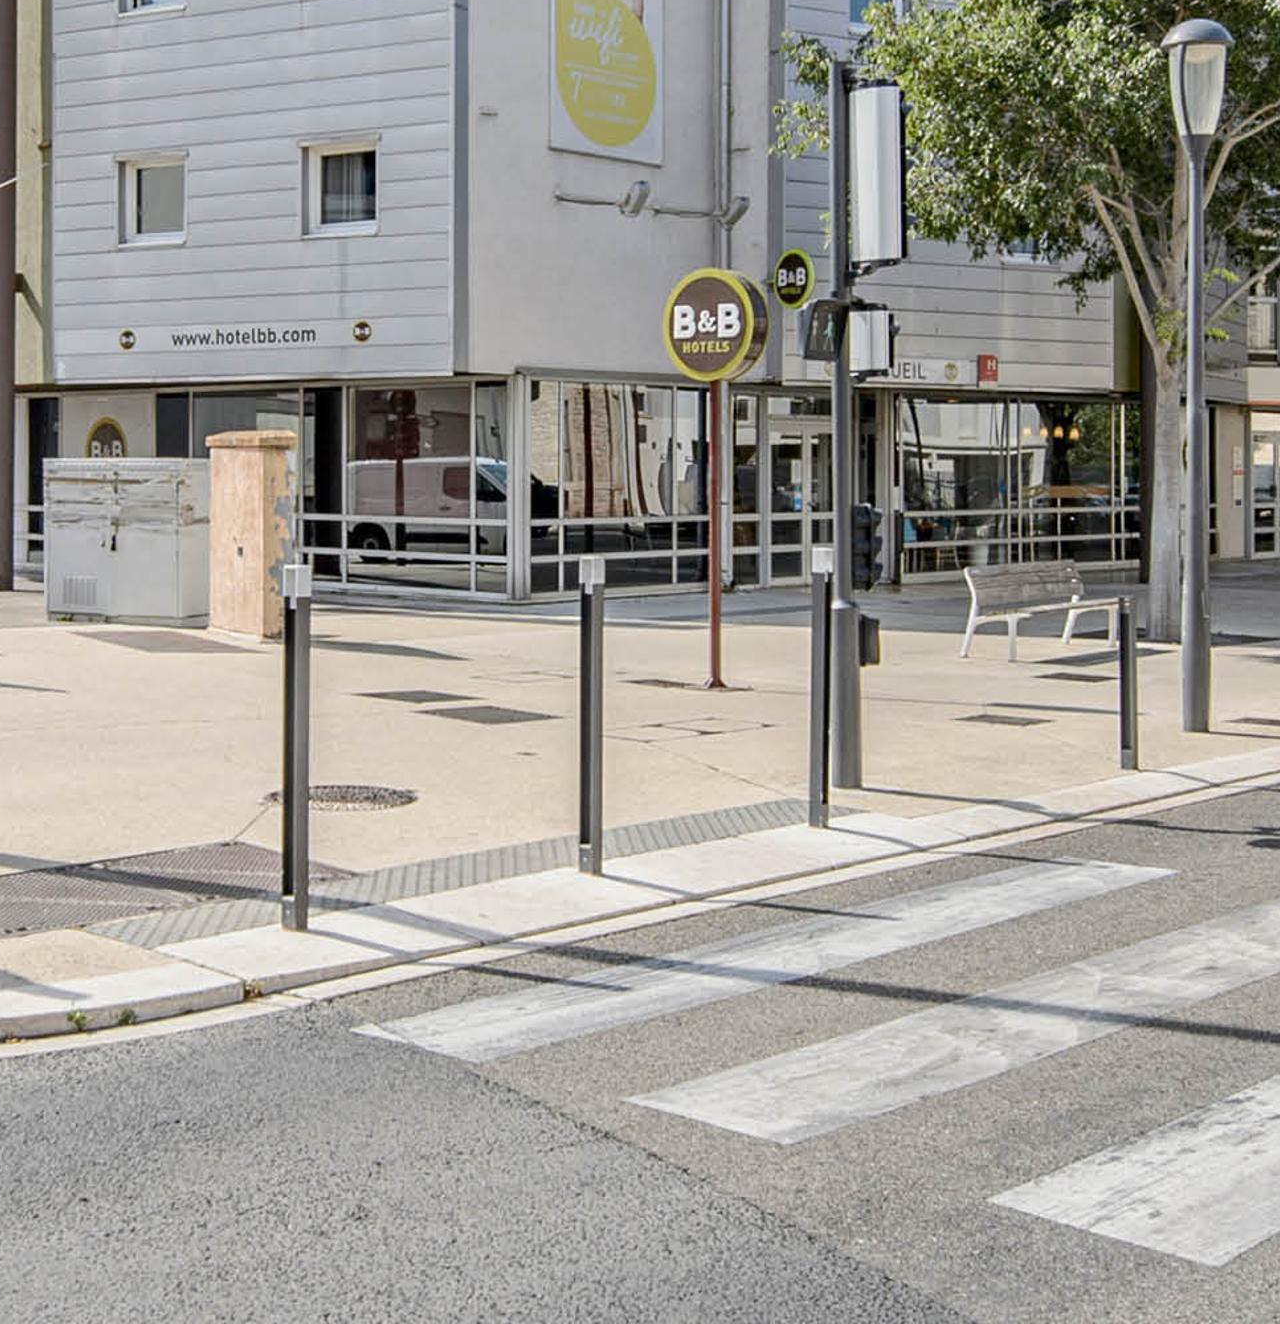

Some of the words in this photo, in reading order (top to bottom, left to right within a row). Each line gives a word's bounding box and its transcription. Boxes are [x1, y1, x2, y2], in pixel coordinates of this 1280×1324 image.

[777, 267, 806, 287] B&B
[673, 302, 741, 339] B&B
[171, 327, 317, 347] www.hotelbb.com
[682, 341, 730, 353] HOTELS
[891, 362, 928, 380] UEIL
